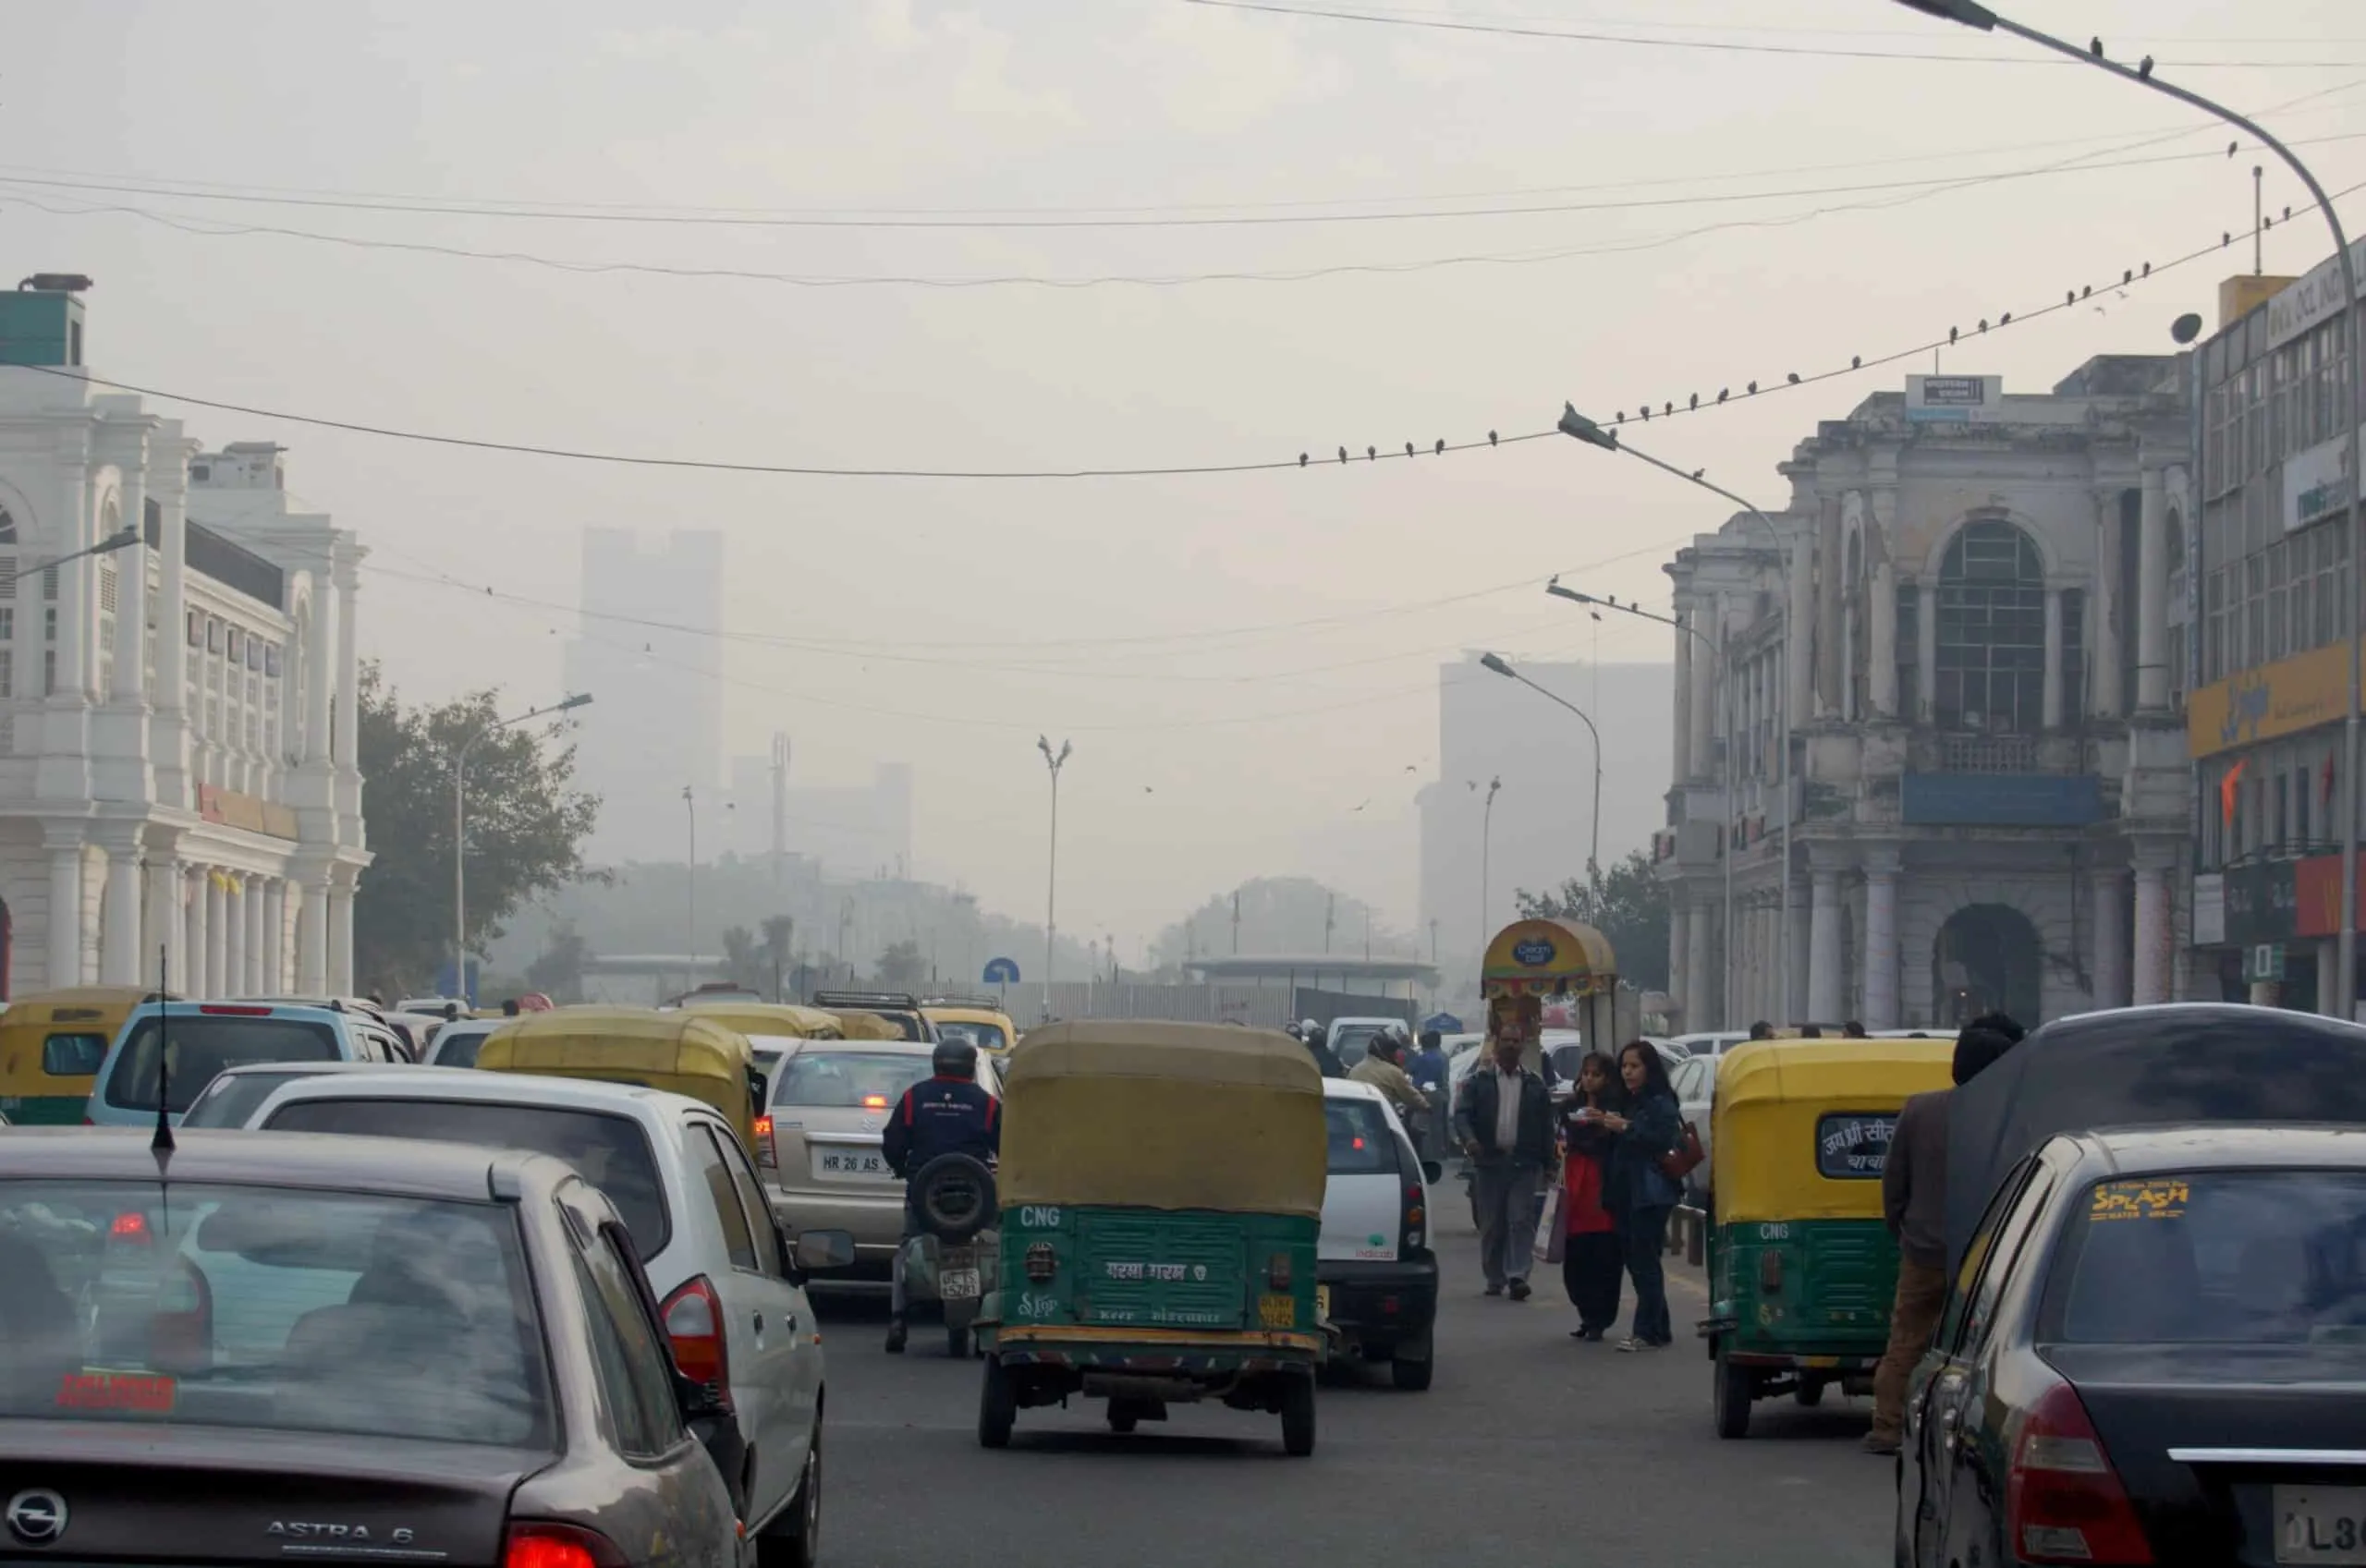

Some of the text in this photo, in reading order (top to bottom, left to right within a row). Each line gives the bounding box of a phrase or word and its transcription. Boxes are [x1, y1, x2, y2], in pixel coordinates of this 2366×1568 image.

[823, 1156, 879, 1170] HR 26 AS
[2092, 1185, 2189, 1210] SPLASH
[1020, 1205, 1060, 1227] CNG
[1760, 1222, 1788, 1240] CNG
[268, 1521, 370, 1538] ASTRA
